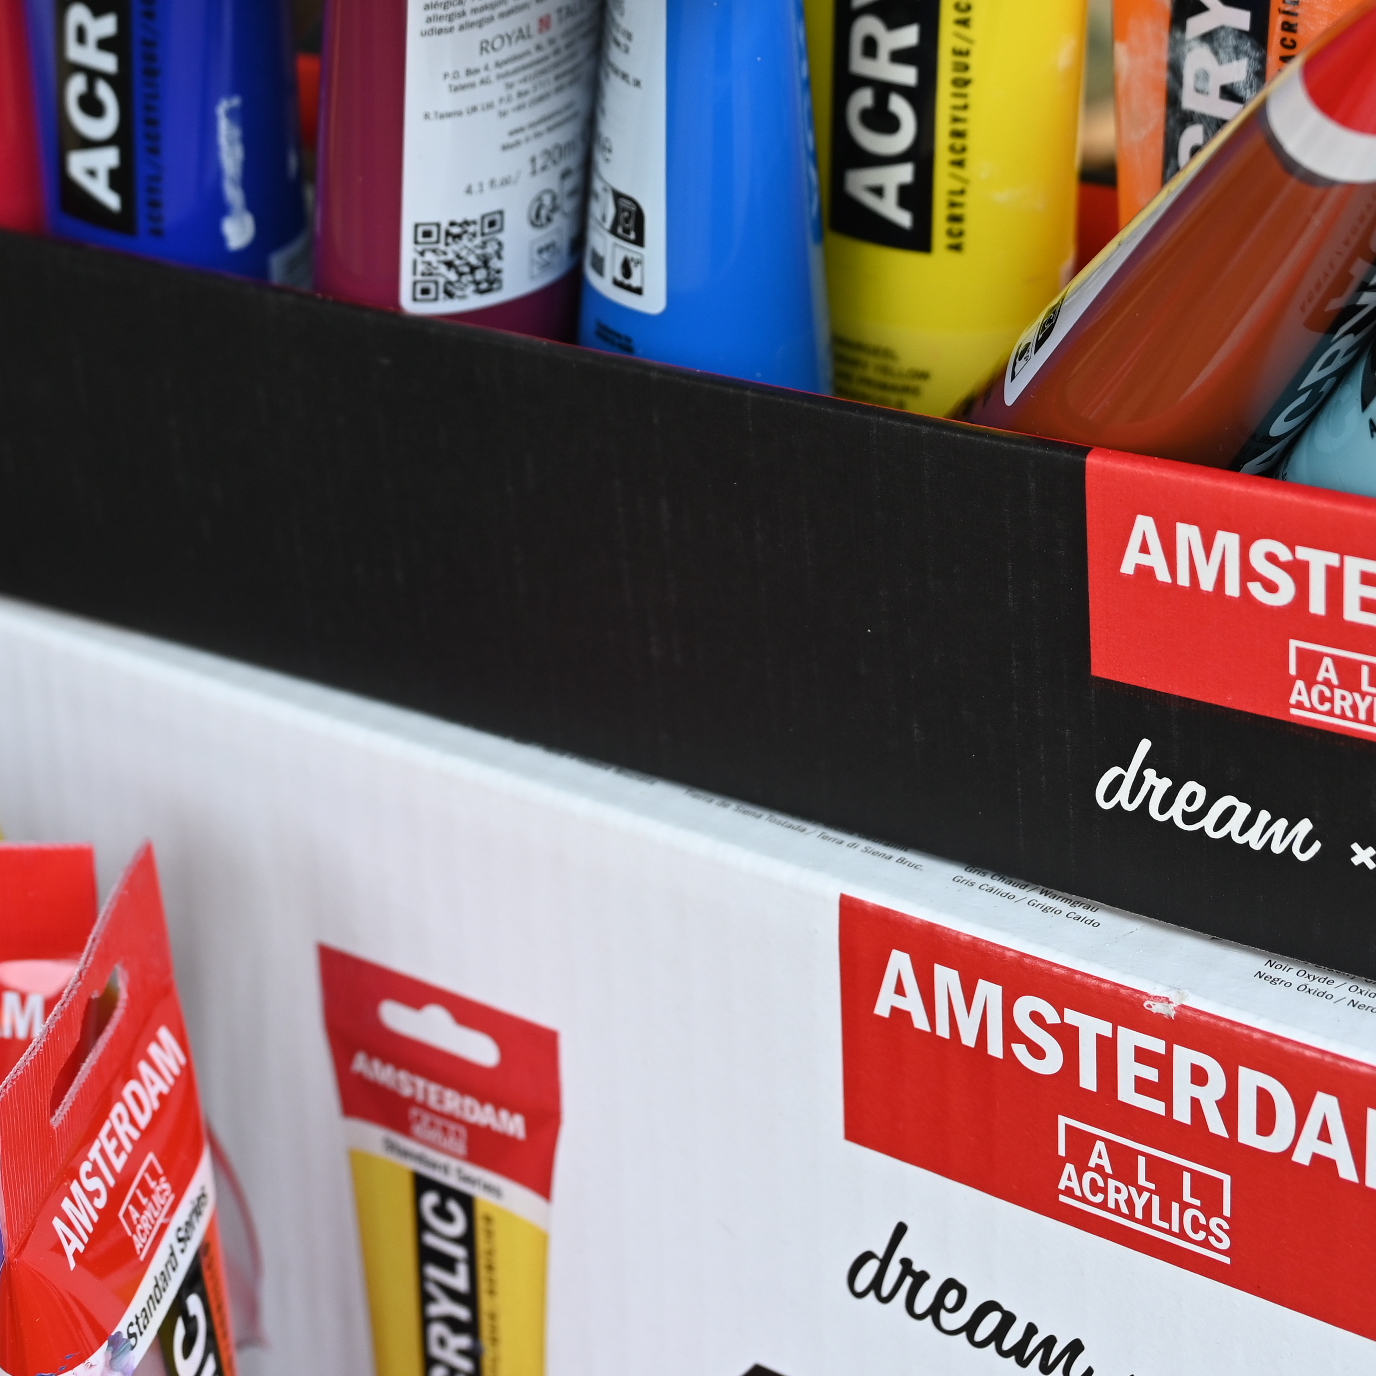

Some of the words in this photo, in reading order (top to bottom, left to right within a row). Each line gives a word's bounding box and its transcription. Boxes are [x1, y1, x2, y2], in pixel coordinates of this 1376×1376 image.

[420, 23, 457, 37] udløse
[458, 13, 496, 32] allergisk
[425, 8, 467, 24] allergisk
[479, 23, 534, 56] ROYAL
[448, 81, 477, 94] Talens
[465, 181, 486, 197] 4.1
[528, 138, 577, 178] 120m
[1094, 737, 1324, 862] dream
[817, 830, 844, 847] Terra
[846, 838, 860, 851] di
[861, 844, 893, 862] Siena
[895, 855, 924, 872] Bruc.
[952, 874, 976, 888] Gris
[978, 881, 1017, 902] Cálido
[1027, 897, 1064, 918] Grigio
[1065, 910, 1102, 929] Caldo
[964, 863, 988, 879] Gris
[990, 871, 1030, 892] Chaud
[1038, 886, 1101, 914] Warmgrau
[1253, 969, 1293, 989] Negro
[1296, 981, 1335, 1002] Óxido
[1264, 958, 1294, 973] Noir
[1296, 968, 1335, 987] Oxyde
[350, 1049, 527, 1141] AMSTERDAM
[50, 1025, 188, 1271] AMSTERDAM
[1087, 1137, 1202, 1208] ALL
[129, 1170, 159, 1221] ALL
[132, 1174, 174, 1256] ACRYLICS
[1057, 1161, 1232, 1252] ACRYLICS
[126, 1248, 180, 1351] Standard
[174, 1183, 209, 1255] Series
[846, 1220, 1095, 1376] dream
